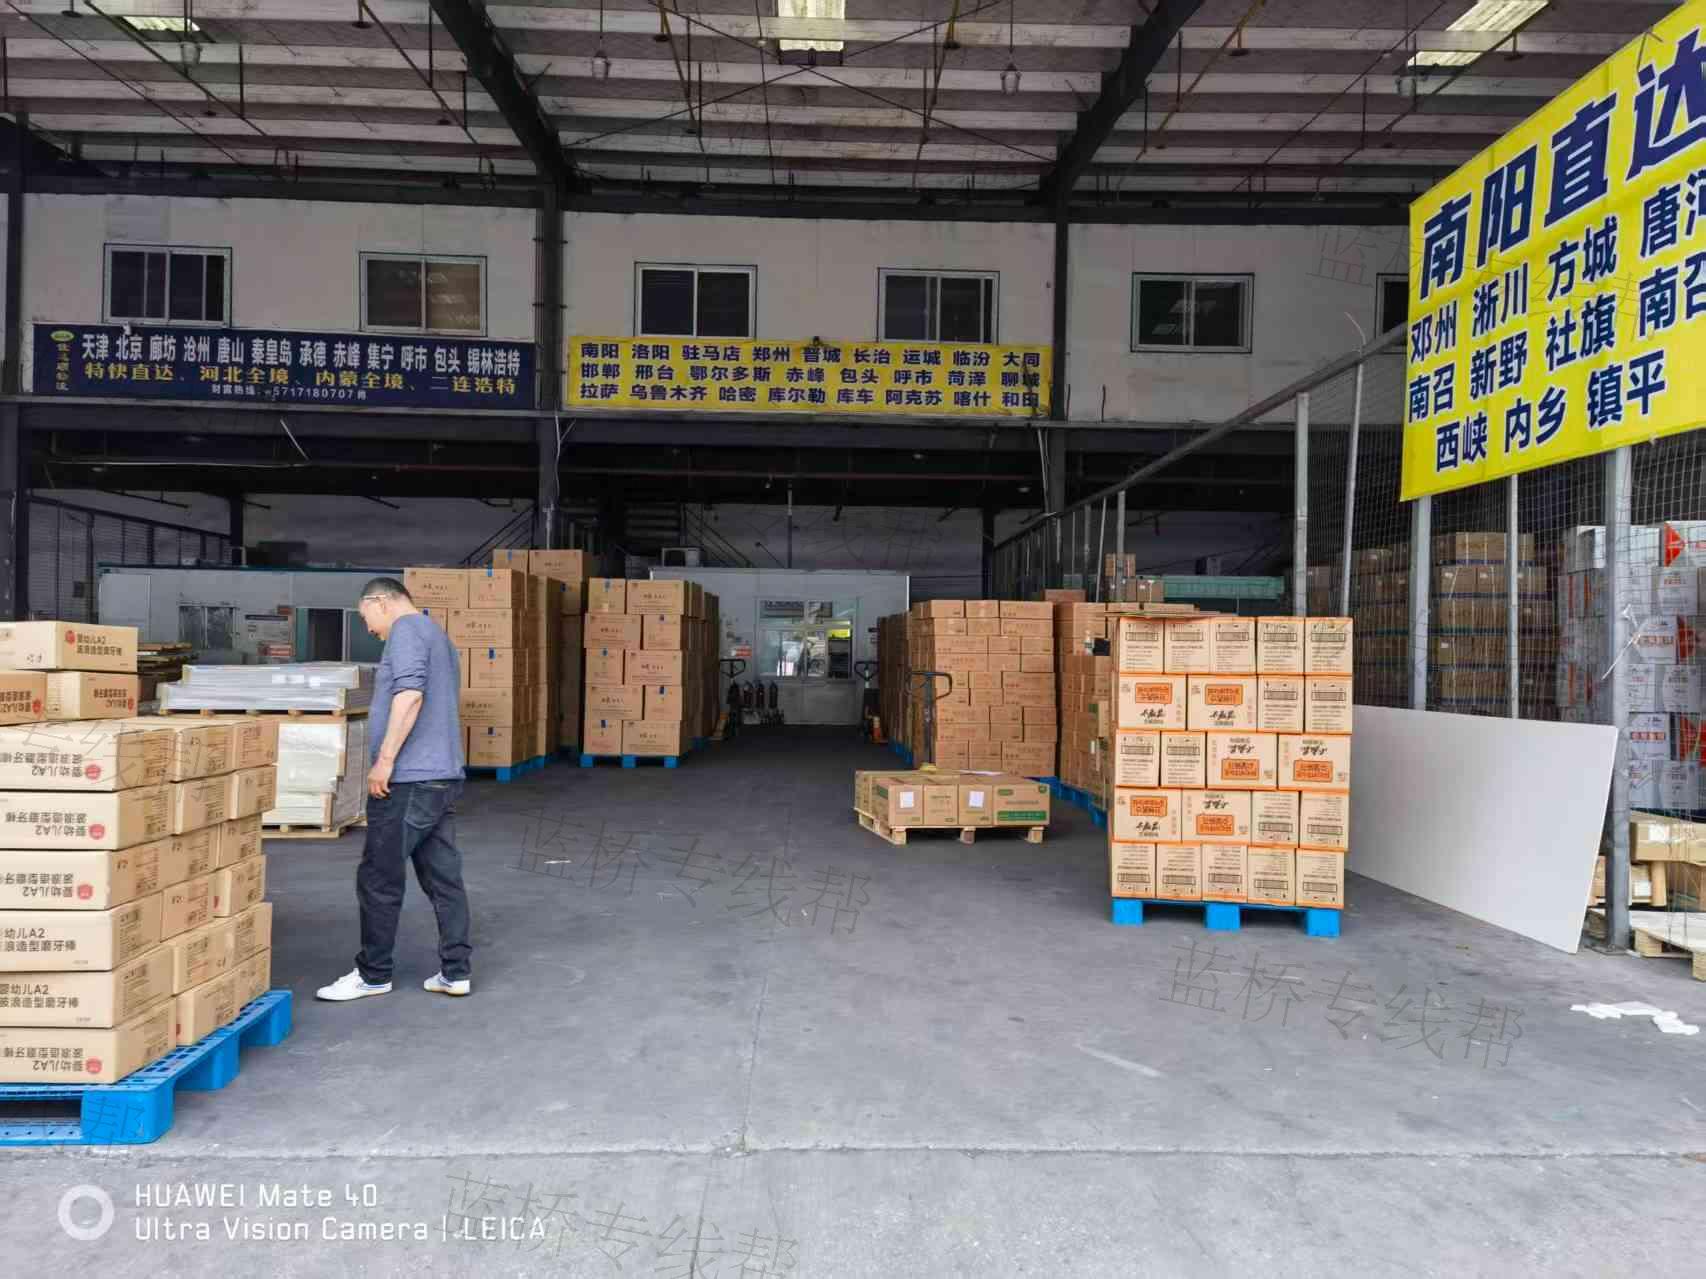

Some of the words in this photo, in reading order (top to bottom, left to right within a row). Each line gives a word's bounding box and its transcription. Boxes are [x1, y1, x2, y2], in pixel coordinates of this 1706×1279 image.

[1420, 28, 1706, 301] 南阳直达
[1411, 301, 1457, 363] 邓州
[1472, 262, 1528, 338] 淅川
[1547, 215, 1618, 302] 方城
[82, 333, 109, 361] 天津
[116, 334, 143, 361] 北京
[149, 335, 176, 362] 廊坊
[183, 336, 210, 363] 沧州
[217, 337, 244, 364] 唐山
[251, 338, 291, 366] 秦皇岛
[299, 340, 326, 367] 承德
[333, 341, 361, 368] 赤峰
[367, 342, 394, 370] 集宁
[401, 345, 427, 371] 呼市
[434, 346, 460, 373] 包头
[467, 348, 520, 376] 锡林浩特
[581, 343, 619, 359] 南阳
[632, 345, 669, 360] 洛阳
[682, 345, 740, 361] 驻马店
[753, 346, 790, 362] 郑州
[803, 348, 841, 364] 晋城
[854, 349, 890, 364] 长治
[903, 350, 941, 365] 运城
[953, 350, 990, 366] 临汾
[1003, 352, 1040, 367] 大同
[1408, 362, 1455, 423] 南召
[1470, 330, 1528, 400] 新野
[1545, 294, 1616, 373] 社旗
[581, 364, 620, 379] 邯郸
[635, 365, 674, 380] 邢台
[690, 366, 771, 382] 鄂尔多斯
[786, 367, 825, 383] 赤峰
[840, 368, 879, 384] 包头
[894, 370, 933, 385] 呼市
[948, 371, 986, 387] 菏泽
[581, 384, 618, 399] 拉萨
[630, 385, 708, 401] 乌鲁木齐
[719, 387, 756, 402] 哈密
[768, 387, 826, 404] 库尔勒
[837, 389, 873, 404] 库车
[885, 390, 942, 405] 阿克苏
[953, 391, 991, 407] 喀什
[1436, 410, 1488, 472] 西峡
[1505, 386, 1567, 452] 内乡
[1587, 350, 1666, 426] 镇平
[0, 873, 74, 885] 波浪造型磨牙
[0, 928, 45, 939] 幼儿A2
[0, 940, 77, 952] 浪造型磨牙棒
